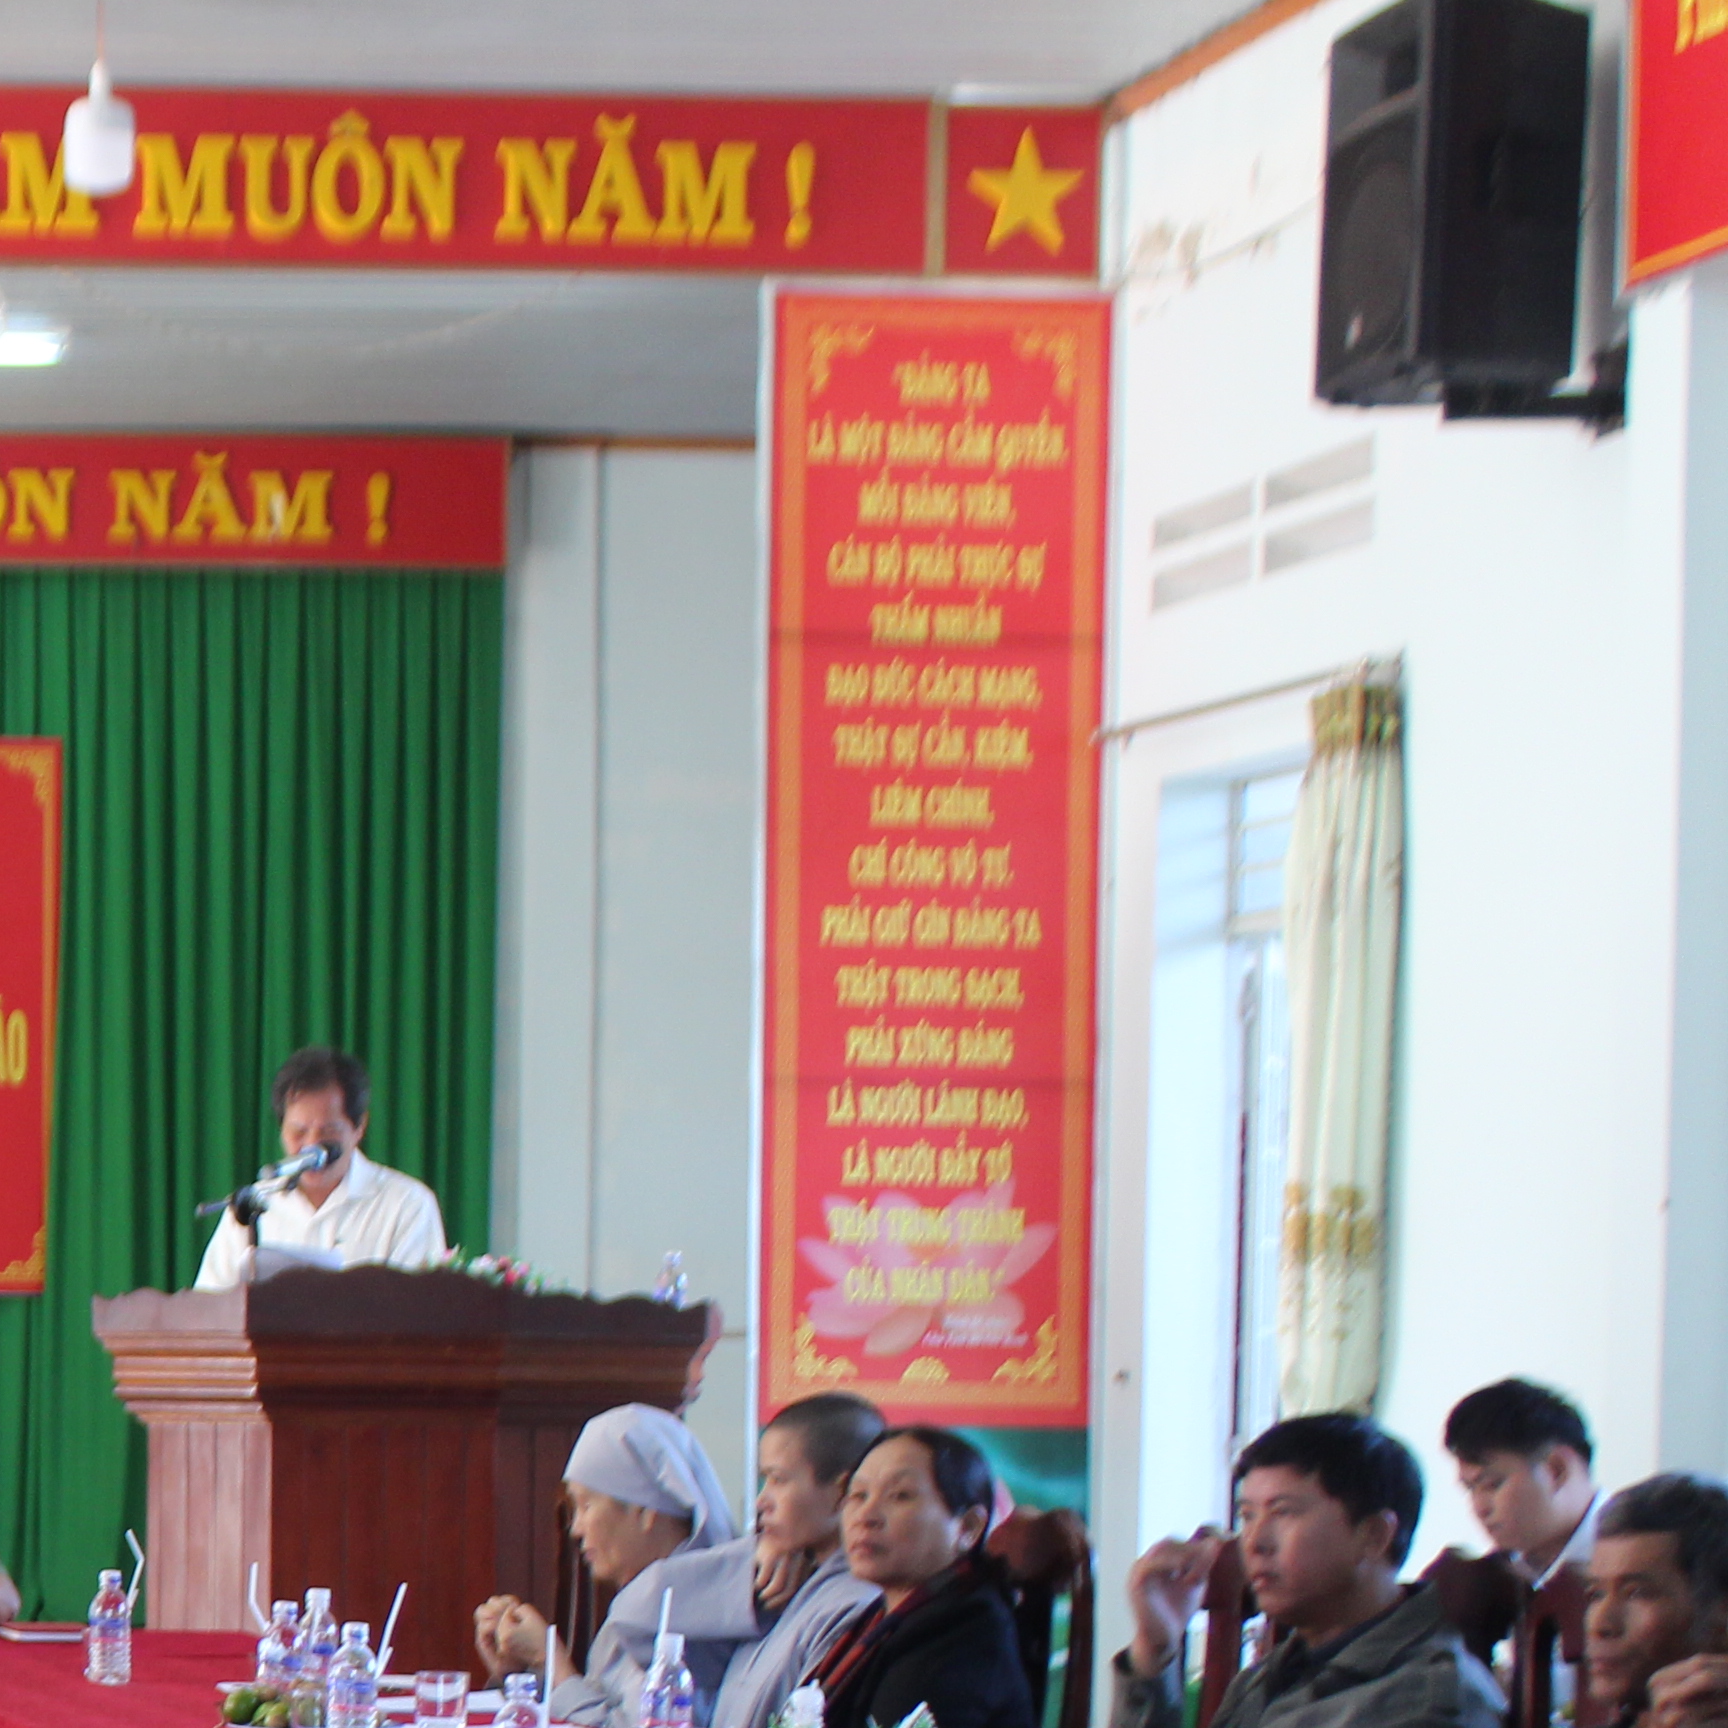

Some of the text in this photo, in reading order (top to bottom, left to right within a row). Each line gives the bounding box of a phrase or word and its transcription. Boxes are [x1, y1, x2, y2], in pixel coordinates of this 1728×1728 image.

[134, 108, 464, 243] MUÔN
[493, 111, 756, 246] NĂM
[784, 140, 815, 249] !
[108, 450, 335, 546] NĂM
[364, 471, 391, 548] !
